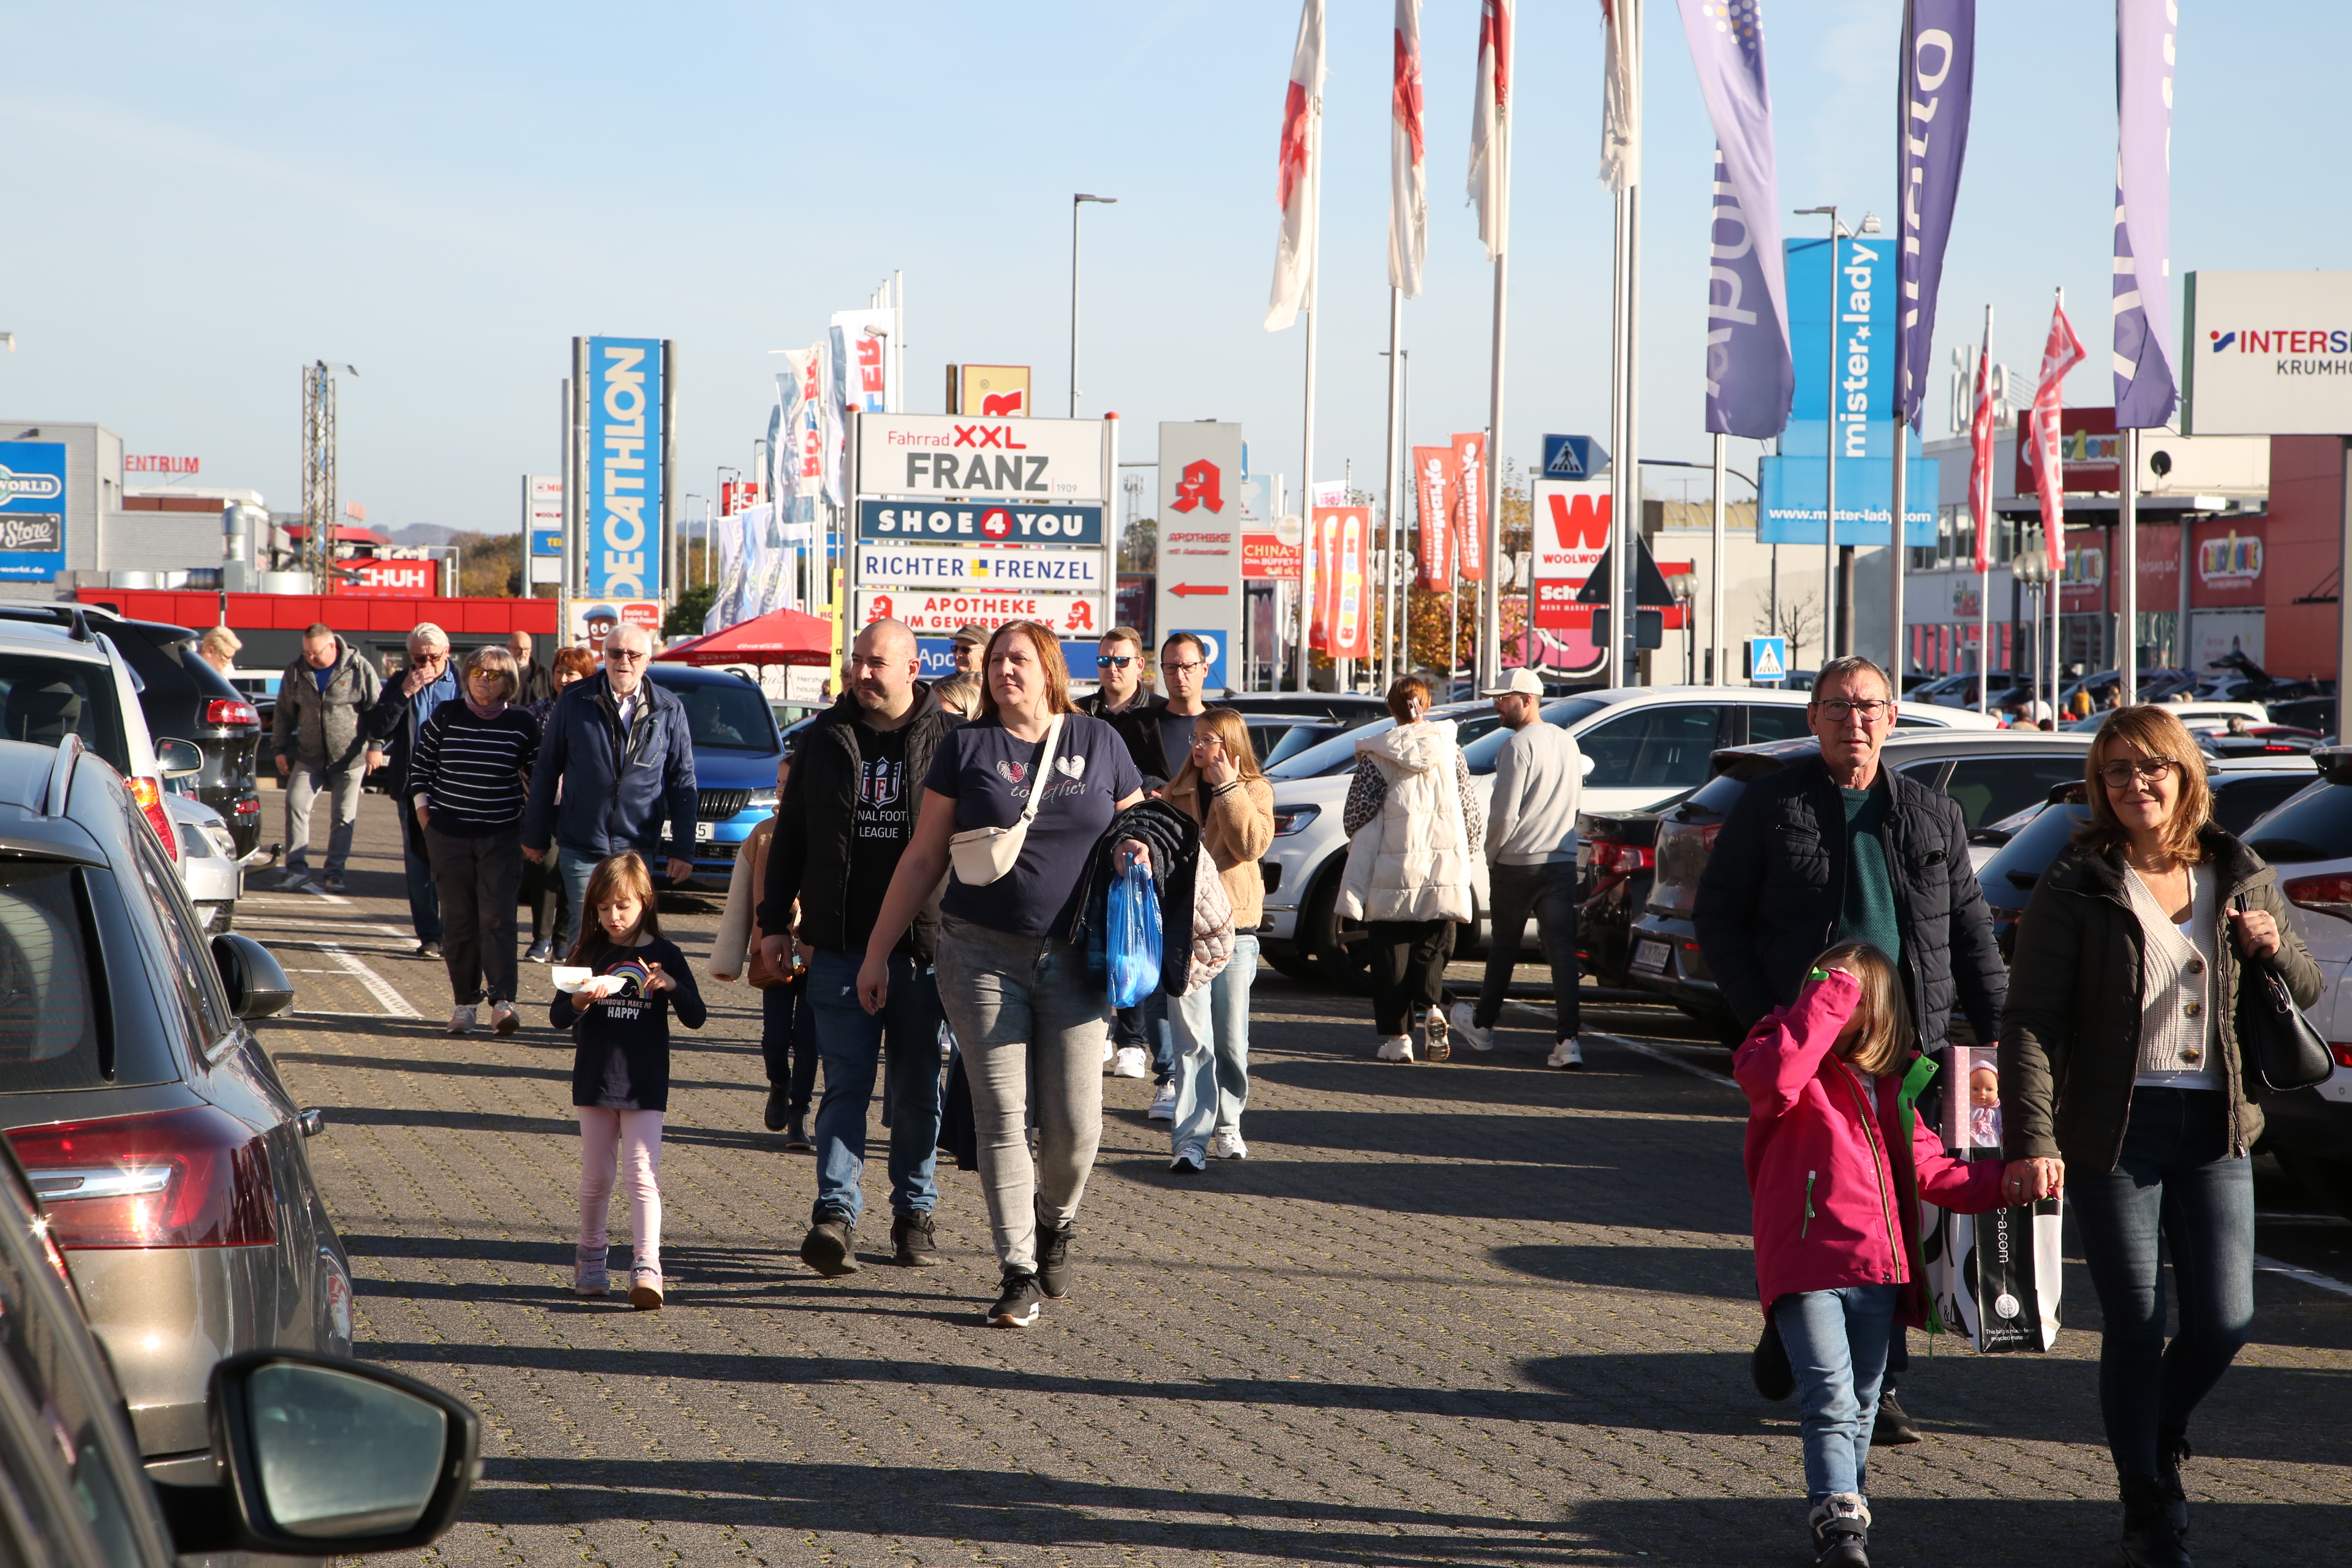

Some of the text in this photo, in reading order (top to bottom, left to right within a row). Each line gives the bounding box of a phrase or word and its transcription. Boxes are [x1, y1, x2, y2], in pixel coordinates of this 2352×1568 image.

[1839, 242, 1879, 458] mister lady
[2241, 330, 2352, 353] INTERS
[2277, 360, 2352, 375] KRUMH
[888, 424, 1027, 450] Fahrrad XXL
[125, 455, 199, 473] ENTRUM
[603, 346, 646, 598] DECATHLON
[906, 452, 1049, 491] FRANZ
[1057, 483, 1078, 492] 1909
[877, 508, 1084, 537] SHOE 4 YOU
[1768, 508, 1931, 524] www.mster-ladycom
[5, 520, 53, 548] Store
[1167, 532, 1231, 543] APOTHEKE
[866, 556, 1095, 579] RICHTER FRENZEL
[924, 597, 1036, 614] APOTHEKE
[904, 614, 1056, 631] IM GEWERBEK
[796, 685, 822, 694] hausg
[1010, 779, 1087, 805] toether
[859, 826, 899, 839] LEAGUE
[627, 1000, 643, 1008] MAKE
[607, 1006, 640, 1020] HAPPY
